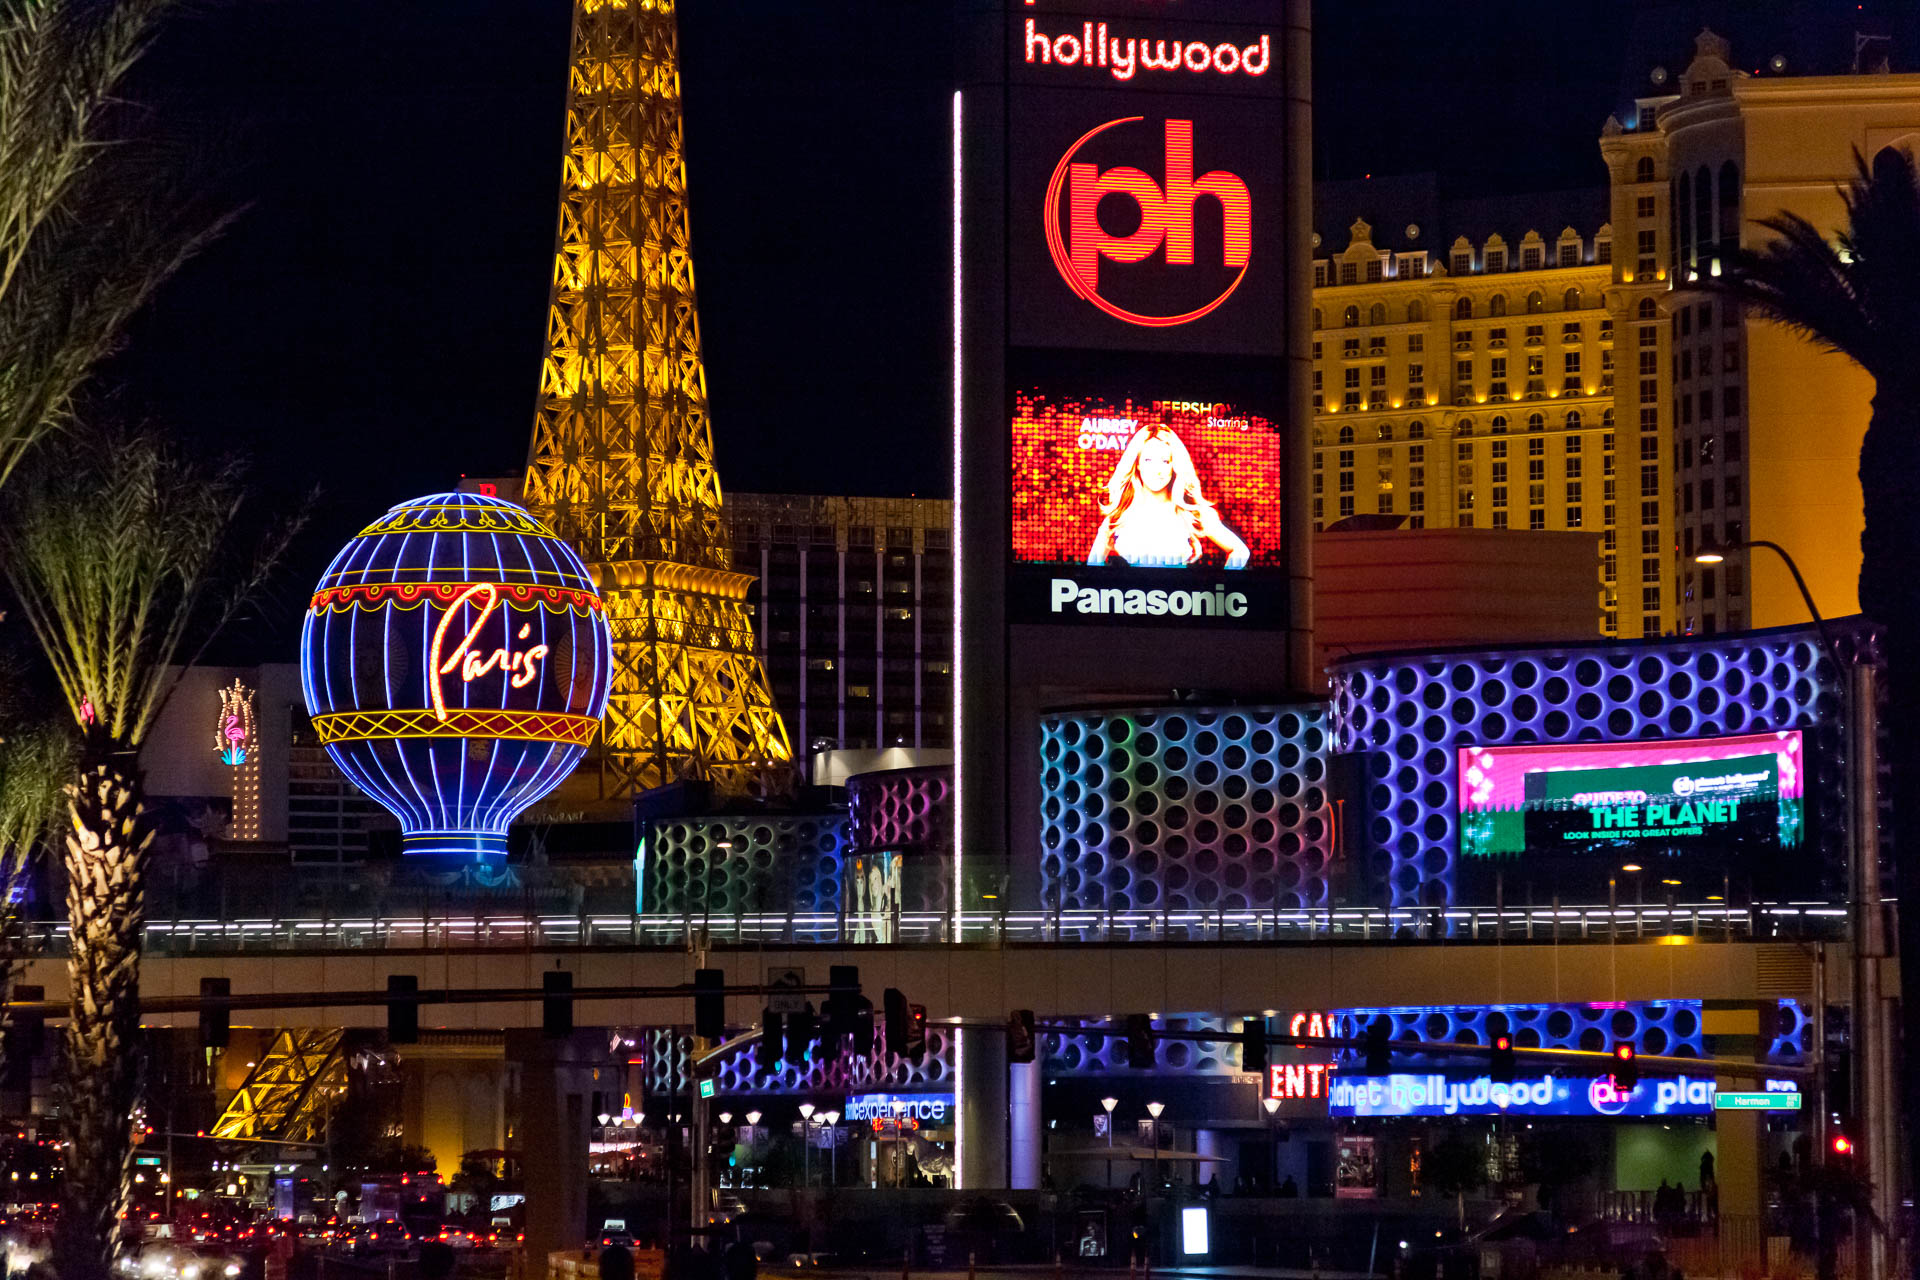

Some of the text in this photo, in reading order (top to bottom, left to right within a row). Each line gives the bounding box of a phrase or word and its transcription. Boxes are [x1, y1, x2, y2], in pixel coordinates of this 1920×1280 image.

[1025, 18, 1270, 81] hollywood
[1069, 118, 1253, 292] ph
[1080, 417, 1138, 434] AUBREY
[1207, 416, 1248, 431] Starring
[1078, 433, 1129, 450] O'DAY
[1051, 578, 1248, 618] Panasonic
[429, 582, 548, 722] Paris
[1589, 799, 1741, 828] THE PLANET
[1563, 827, 1704, 840] LOOK INSIDE FOR GREAT OFFERS
[1329, 1078, 1382, 1114] planet
[1391, 1074, 1553, 1115] hollywood
[1734, 1096, 1770, 1106] Harmon
